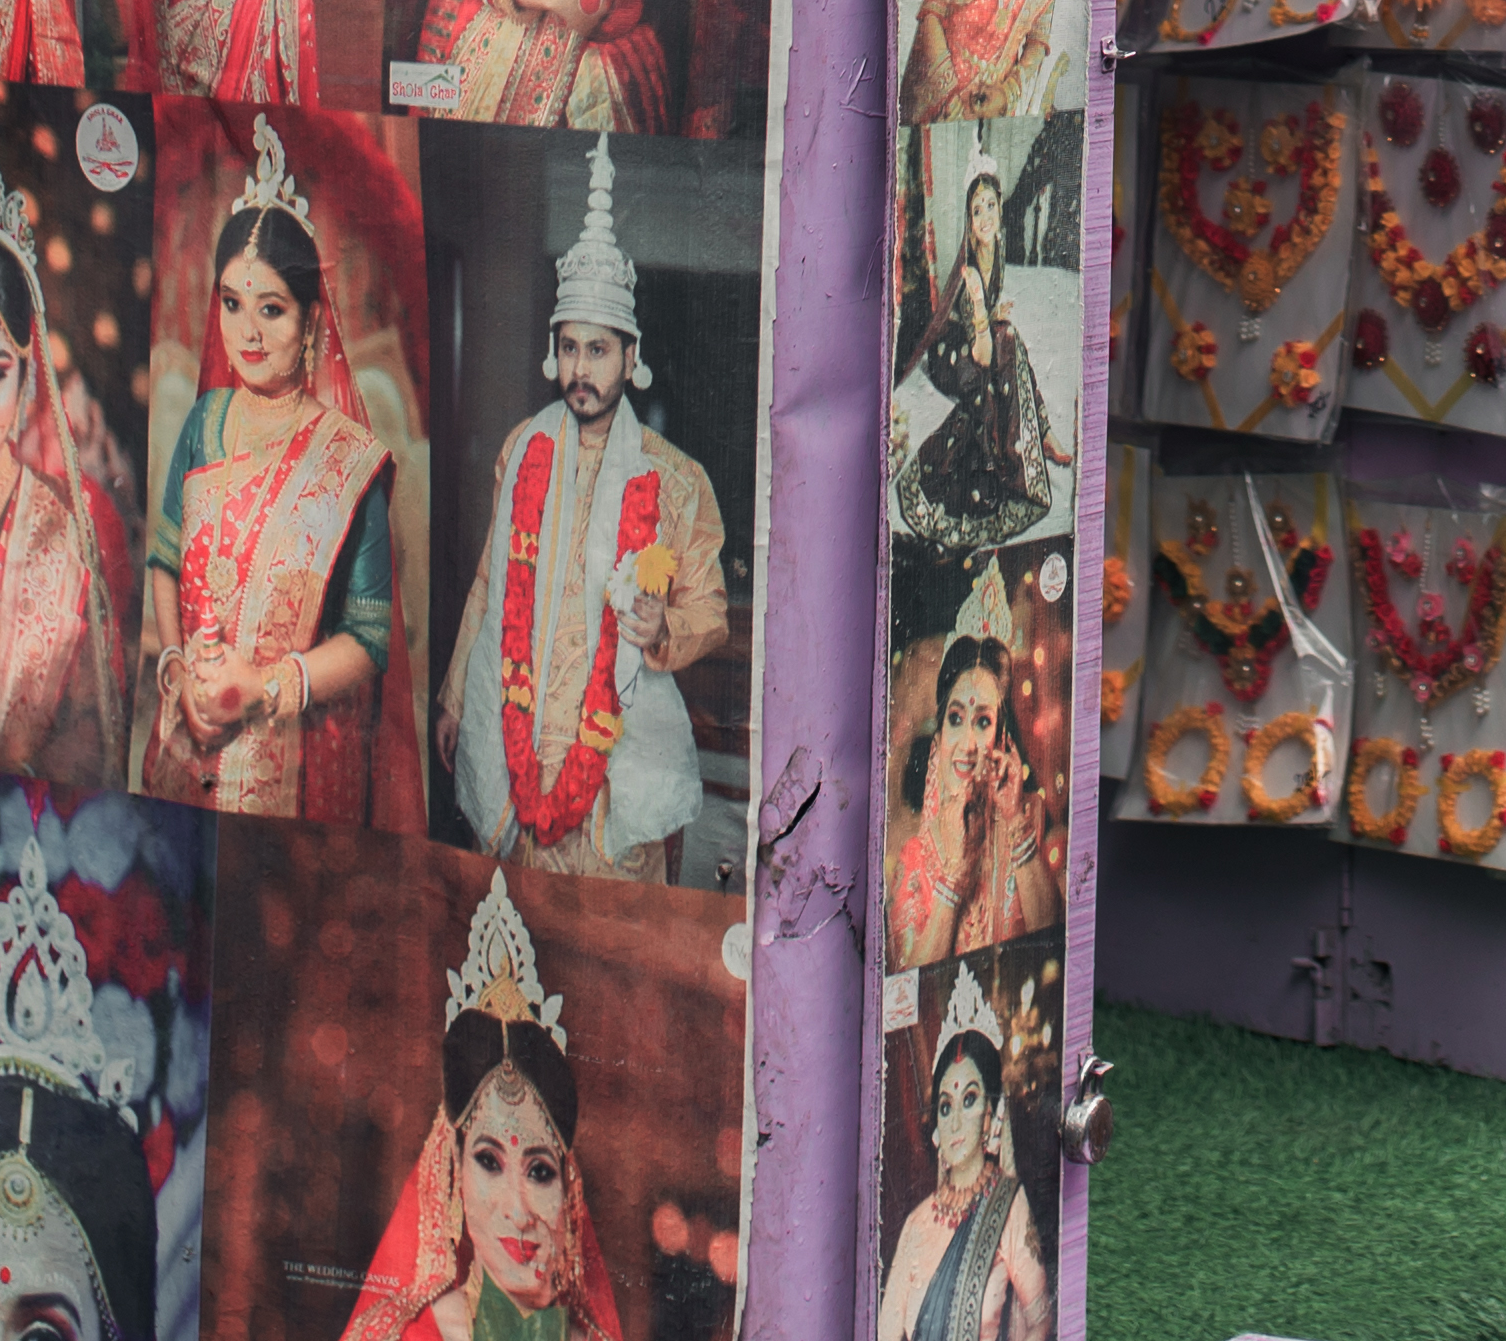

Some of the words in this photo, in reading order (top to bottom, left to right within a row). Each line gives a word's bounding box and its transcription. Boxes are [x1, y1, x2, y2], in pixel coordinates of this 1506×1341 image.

[282, 1259, 305, 1273] THE
[306, 1263, 359, 1280] WEDDING
[359, 1270, 401, 1288] CANVAS
